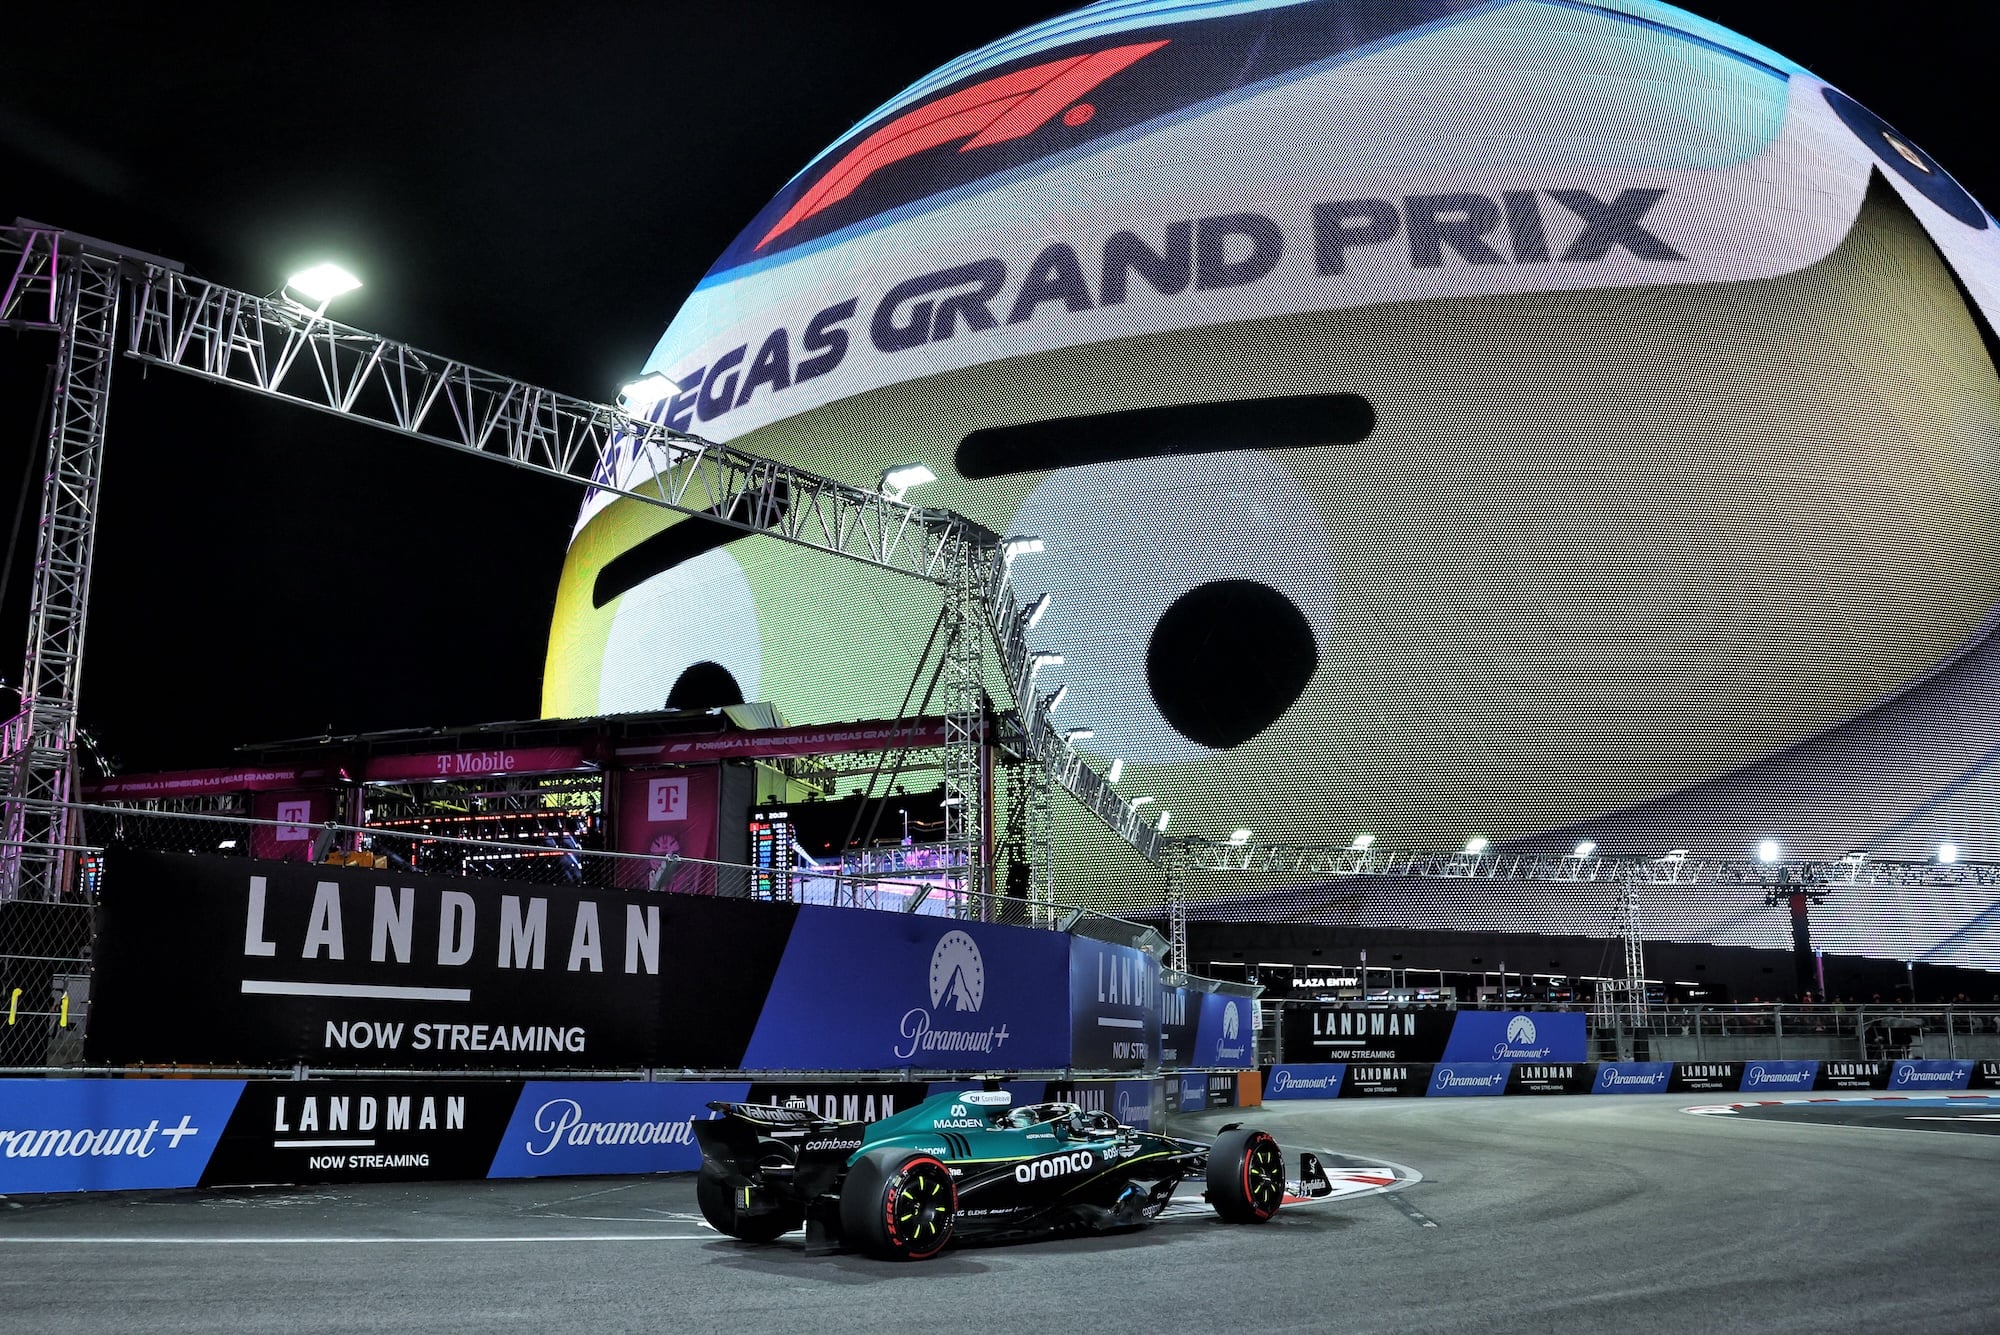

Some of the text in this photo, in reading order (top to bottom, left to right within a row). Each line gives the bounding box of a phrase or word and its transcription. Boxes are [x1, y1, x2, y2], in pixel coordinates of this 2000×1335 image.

[870, 212, 1283, 353] GRAND
[1313, 186, 1688, 277] PRIX
[695, 737, 743, 751] FORMULA
[803, 734, 825, 744] LAS
[825, 731, 862, 742] VEGAS
[862, 728, 900, 740] GRAND
[455, 750, 515, 773] Mobile
[121, 780, 159, 792] FORMULA
[244, 876, 661, 975] LANDMAN
[1292, 977, 1358, 987] PLAZA ENTRY
[894, 1007, 1010, 1059] Paramount+
[1313, 1013, 1415, 1035] LANDMAN
[325, 1021, 586, 1053] NOW STREAMING
[1113, 1042, 1130, 1059] NOW
[1331, 1050, 1395, 1059] NOW STREAMING
[1492, 1043, 1551, 1061] Paramount+
[1354, 1068, 1407, 1080] LANDMAN
[1436, 1068, 1502, 1089] Paramount+
[1521, 1066, 1573, 1079] LANDMAN
[1602, 1067, 1664, 1088] Paramount+
[1682, 1065, 1731, 1077] LANDMAN
[1749, 1066, 1811, 1086] Paramount+
[1827, 1063, 1879, 1075] LANDMAN
[1898, 1065, 1965, 1085] Paramount+
[1273, 1070, 1337, 1092] Paramount+
[274, 1096, 464, 1133] LANDMAN
[740, 1105, 806, 1121] Valvoline
[786, 1100, 806, 1109] arm
[526, 1098, 717, 1156] Paramount
[934, 1119, 983, 1129] MAADEN
[805, 1138, 861, 1150] coinbase
[309, 1153, 429, 1169] NOW STREAMING
[1015, 1151, 1093, 1183] aramco
